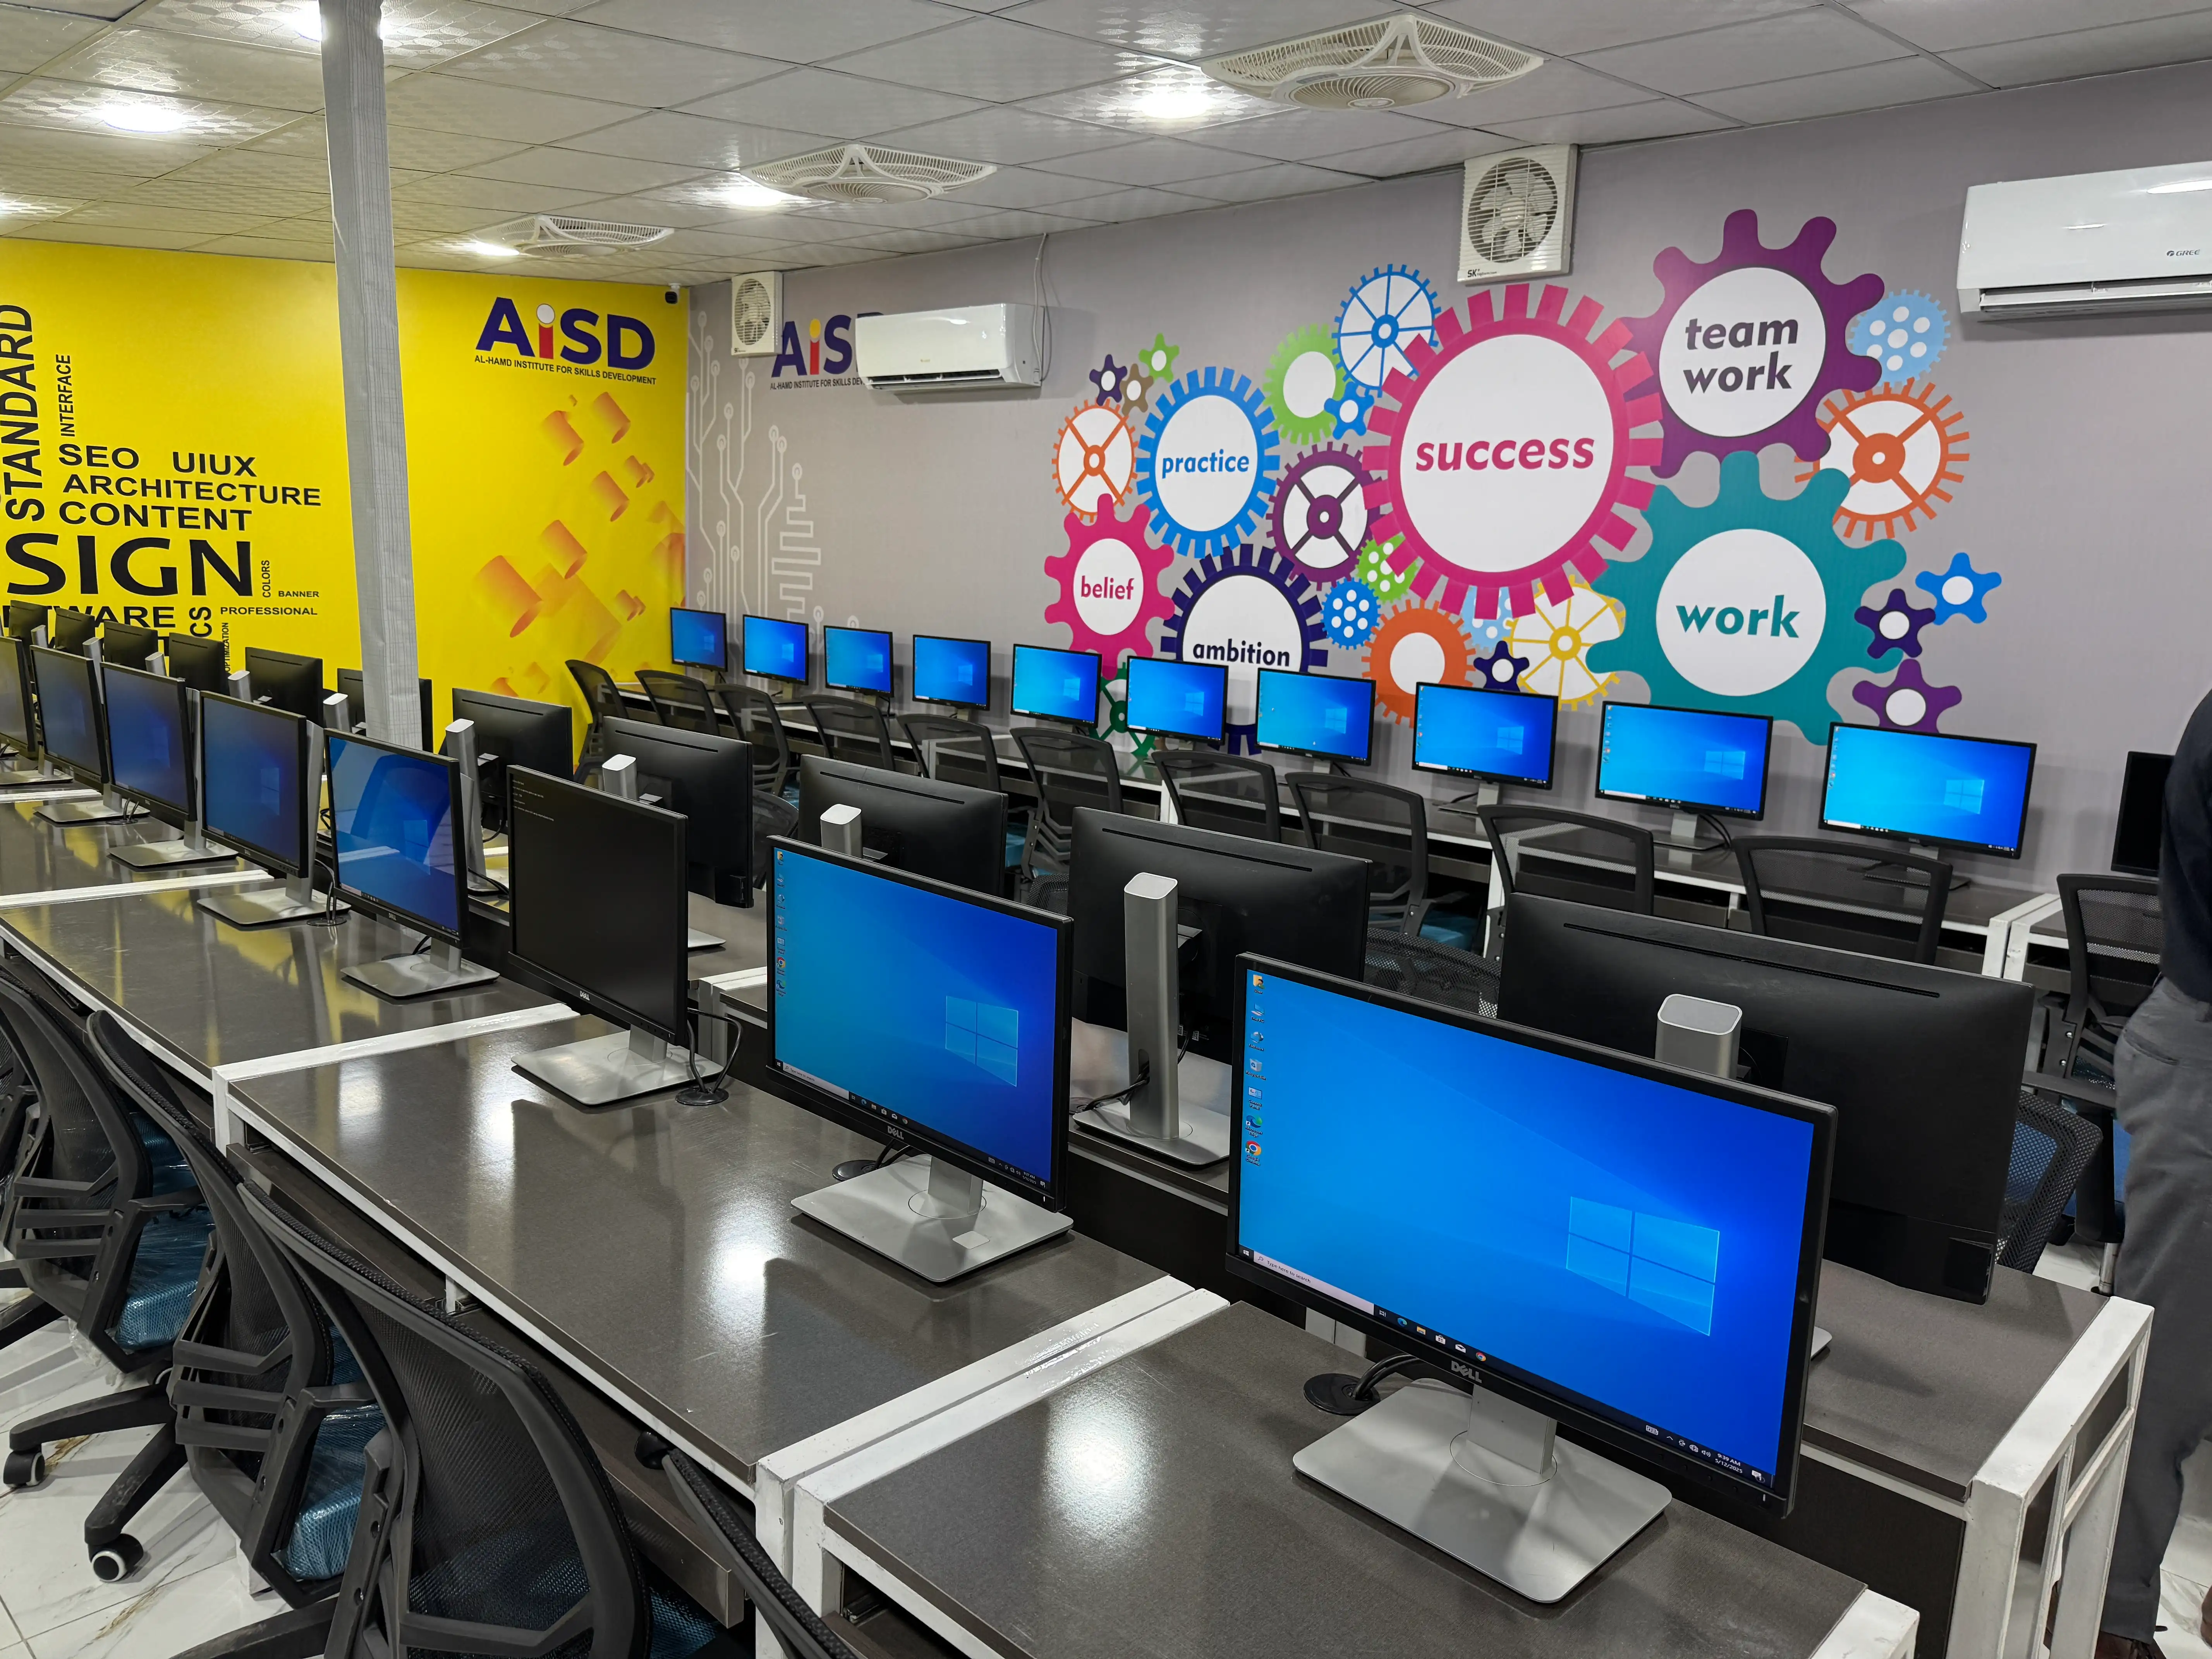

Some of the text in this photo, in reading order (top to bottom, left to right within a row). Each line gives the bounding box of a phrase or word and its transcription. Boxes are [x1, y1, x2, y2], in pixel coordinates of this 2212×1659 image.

[771, 312, 884, 377] AiS
[1685, 318, 1798, 350] team
[475, 355, 656, 385] AL-HAMD INSTITUTE FOR SKILLS DEVELOPMENT
[770, 382, 793, 390] AL-HAMD
[794, 380, 819, 388] INSTITUTE
[833, 378, 851, 386] SKILLS
[1683, 351, 1793, 394] work
[56, 354, 75, 437] INTERFACE
[0, 304, 45, 521] STANDARD
[59, 444, 257, 477] SEO UIUX
[1162, 448, 1249, 479] practice
[1416, 437, 1595, 471] success
[63, 474, 321, 506] ARCHITECTURE
[59, 501, 252, 531] CONTENT
[5, 532, 253, 596] SIGN
[261, 560, 271, 598] COLORS
[1081, 575, 1134, 600] belief
[220, 607, 318, 615] PROFESSIONAL
[1676, 594, 1800, 638] work
[222, 622, 231, 672] OPTIMIZATION
[1193, 638, 1290, 667] ambition
[888, 1125, 904, 1140] DELL
[1451, 1360, 1482, 1383] DELL
[1715, 1458, 1743, 1474] 5/12/2025
